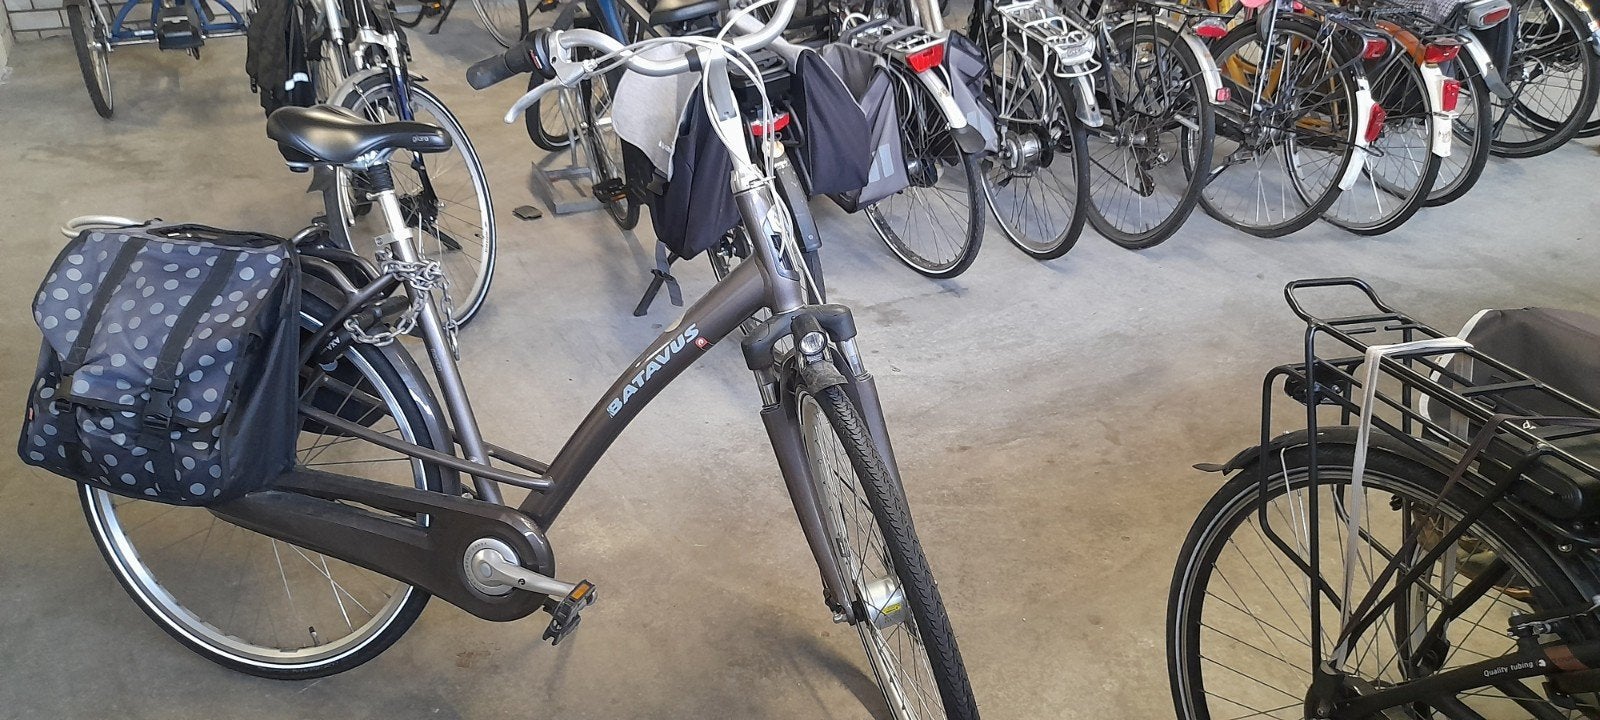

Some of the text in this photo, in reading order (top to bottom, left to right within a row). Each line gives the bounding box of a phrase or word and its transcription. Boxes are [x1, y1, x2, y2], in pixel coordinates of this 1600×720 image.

[326, 336, 340, 351] AXA
[606, 323, 699, 418] BATAVUS
[1483, 661, 1534, 677] Quality tubing
